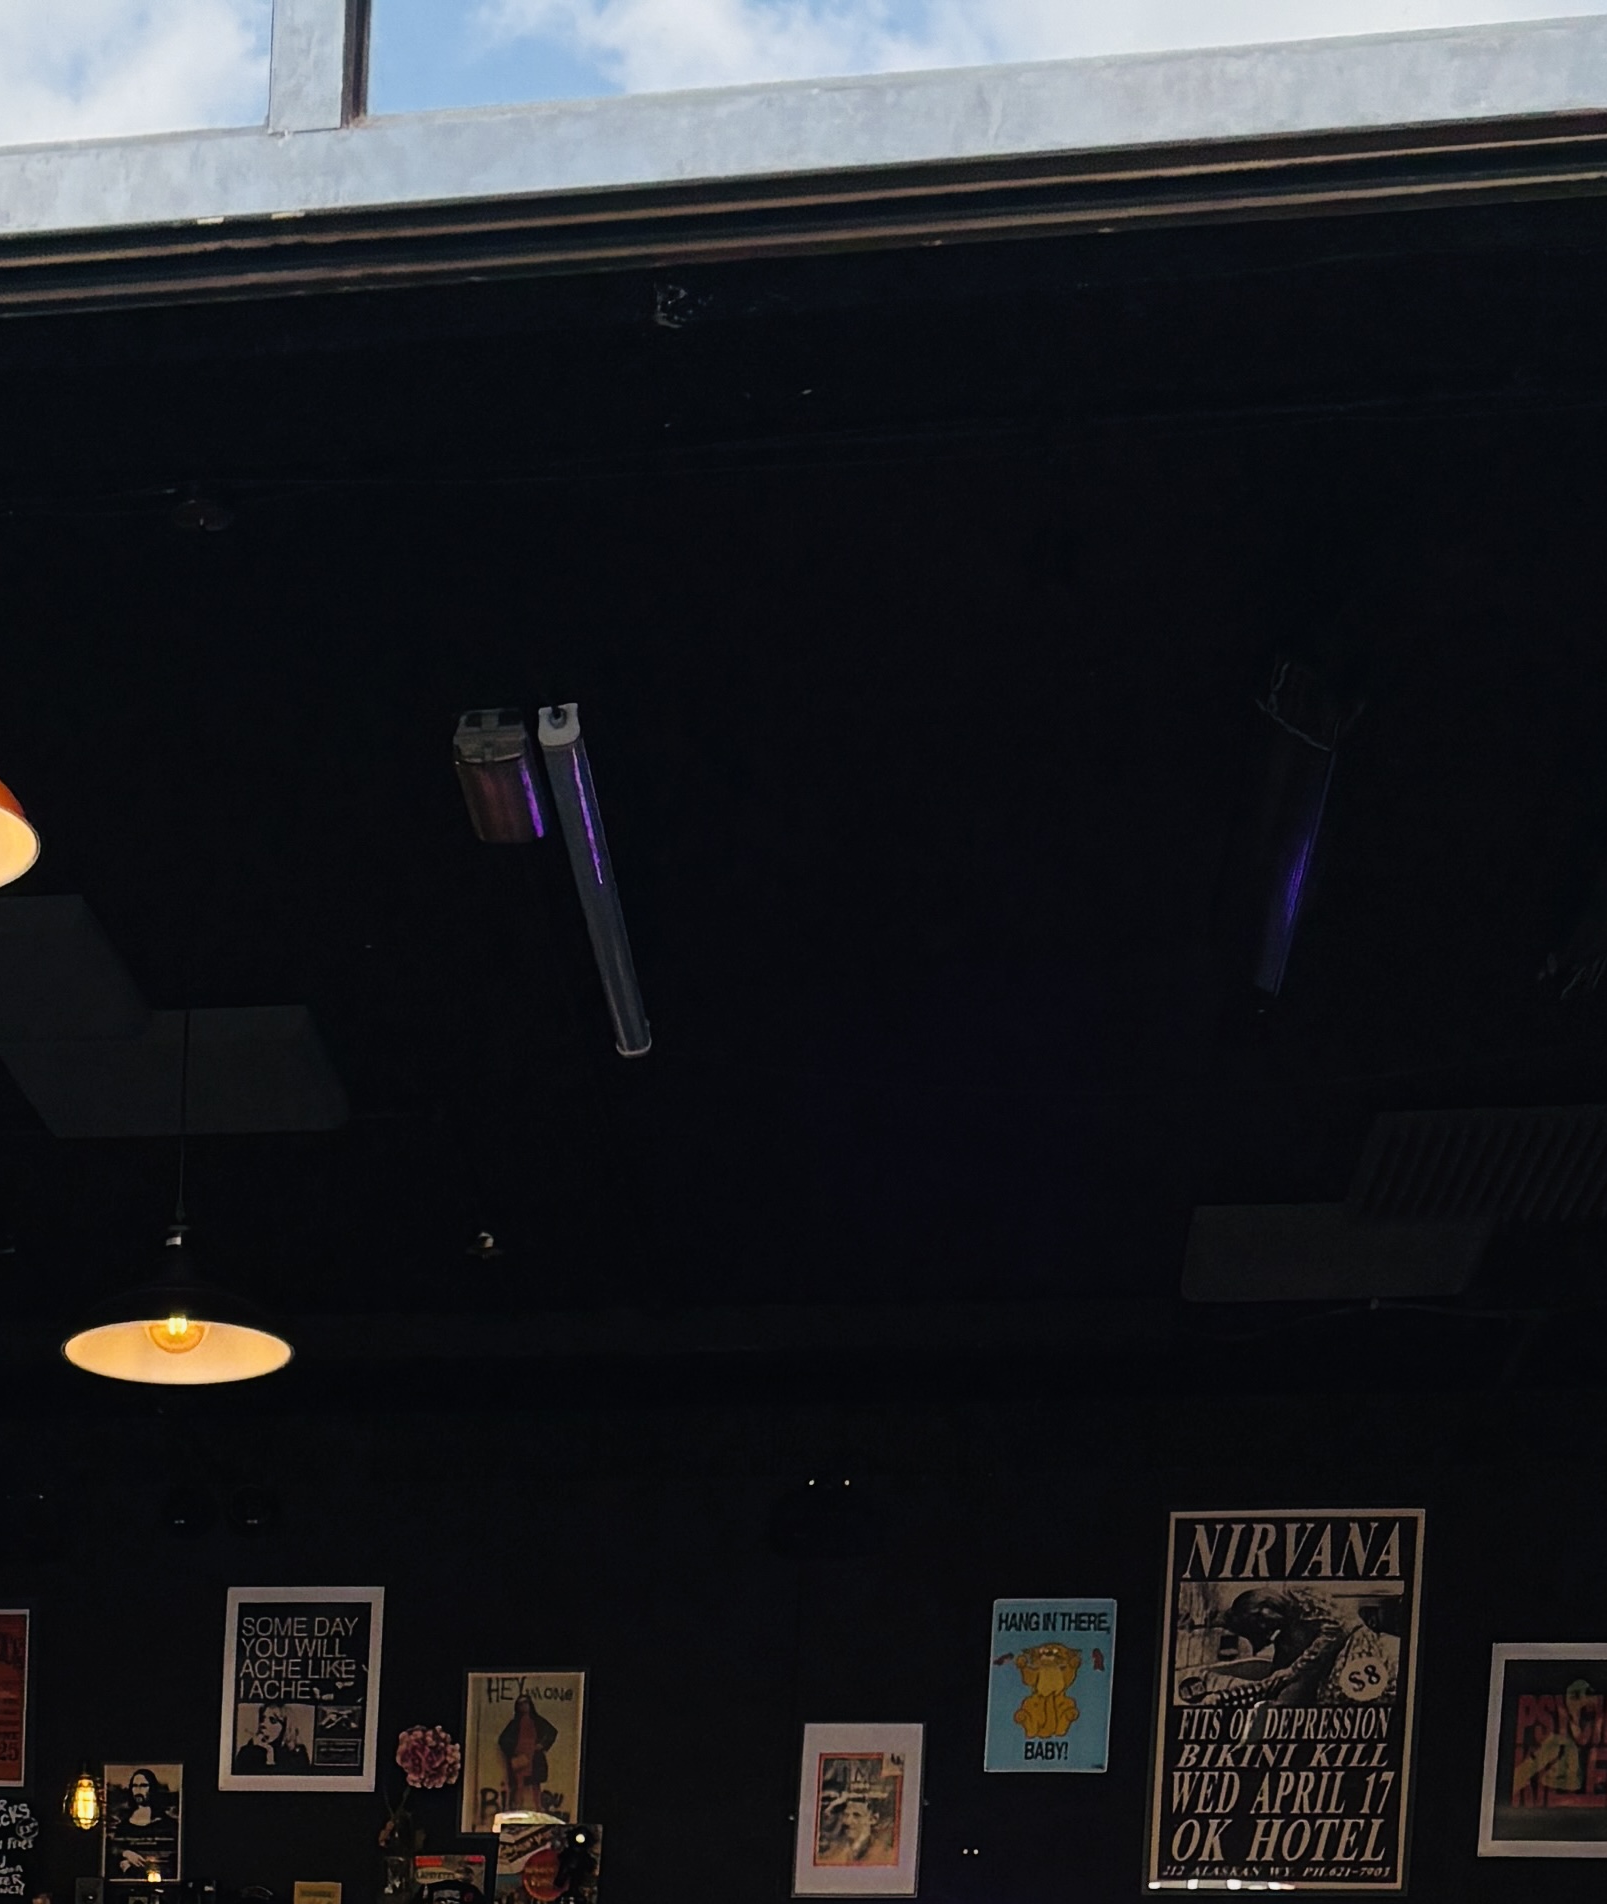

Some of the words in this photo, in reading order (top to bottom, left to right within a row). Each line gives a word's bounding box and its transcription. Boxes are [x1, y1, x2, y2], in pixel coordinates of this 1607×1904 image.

[1180, 1521, 1402, 1580] NIRVANA
[241, 1616, 307, 1638] SOME
[314, 1616, 359, 1638] DAY
[997, 1612, 1040, 1632] HANG
[1042, 1612, 1059, 1632] IN
[1060, 1612, 1112, 1634] THERE,
[240, 1637, 289, 1658] YOU
[294, 1637, 347, 1658] WILL
[239, 1658, 303, 1679] ACHE
[307, 1658, 356, 1679] LIKE
[239, 1679, 245, 1700] I
[248, 1679, 311, 1700] ACHE
[486, 1676, 528, 1704] HEY
[1176, 1707, 1222, 1742] FITS
[1227, 1707, 1262, 1741] OF
[1262, 1706, 1393, 1742] DEPRESSION
[1024, 1742, 1069, 1761] BABY!
[1176, 1744, 1297, 1769] BIKINI
[1306, 1744, 1392, 1769] KILL
[1171, 1771, 1243, 1815] WED
[1248, 1771, 1350, 1815] APRIL
[1358, 1770, 1396, 1815] 17
[1170, 1818, 1236, 1863] OK
[1244, 1818, 1389, 1863] HOTEL
[1160, 1864, 1188, 1878] 212
[1191, 1864, 1263, 1878] ALASKAN
